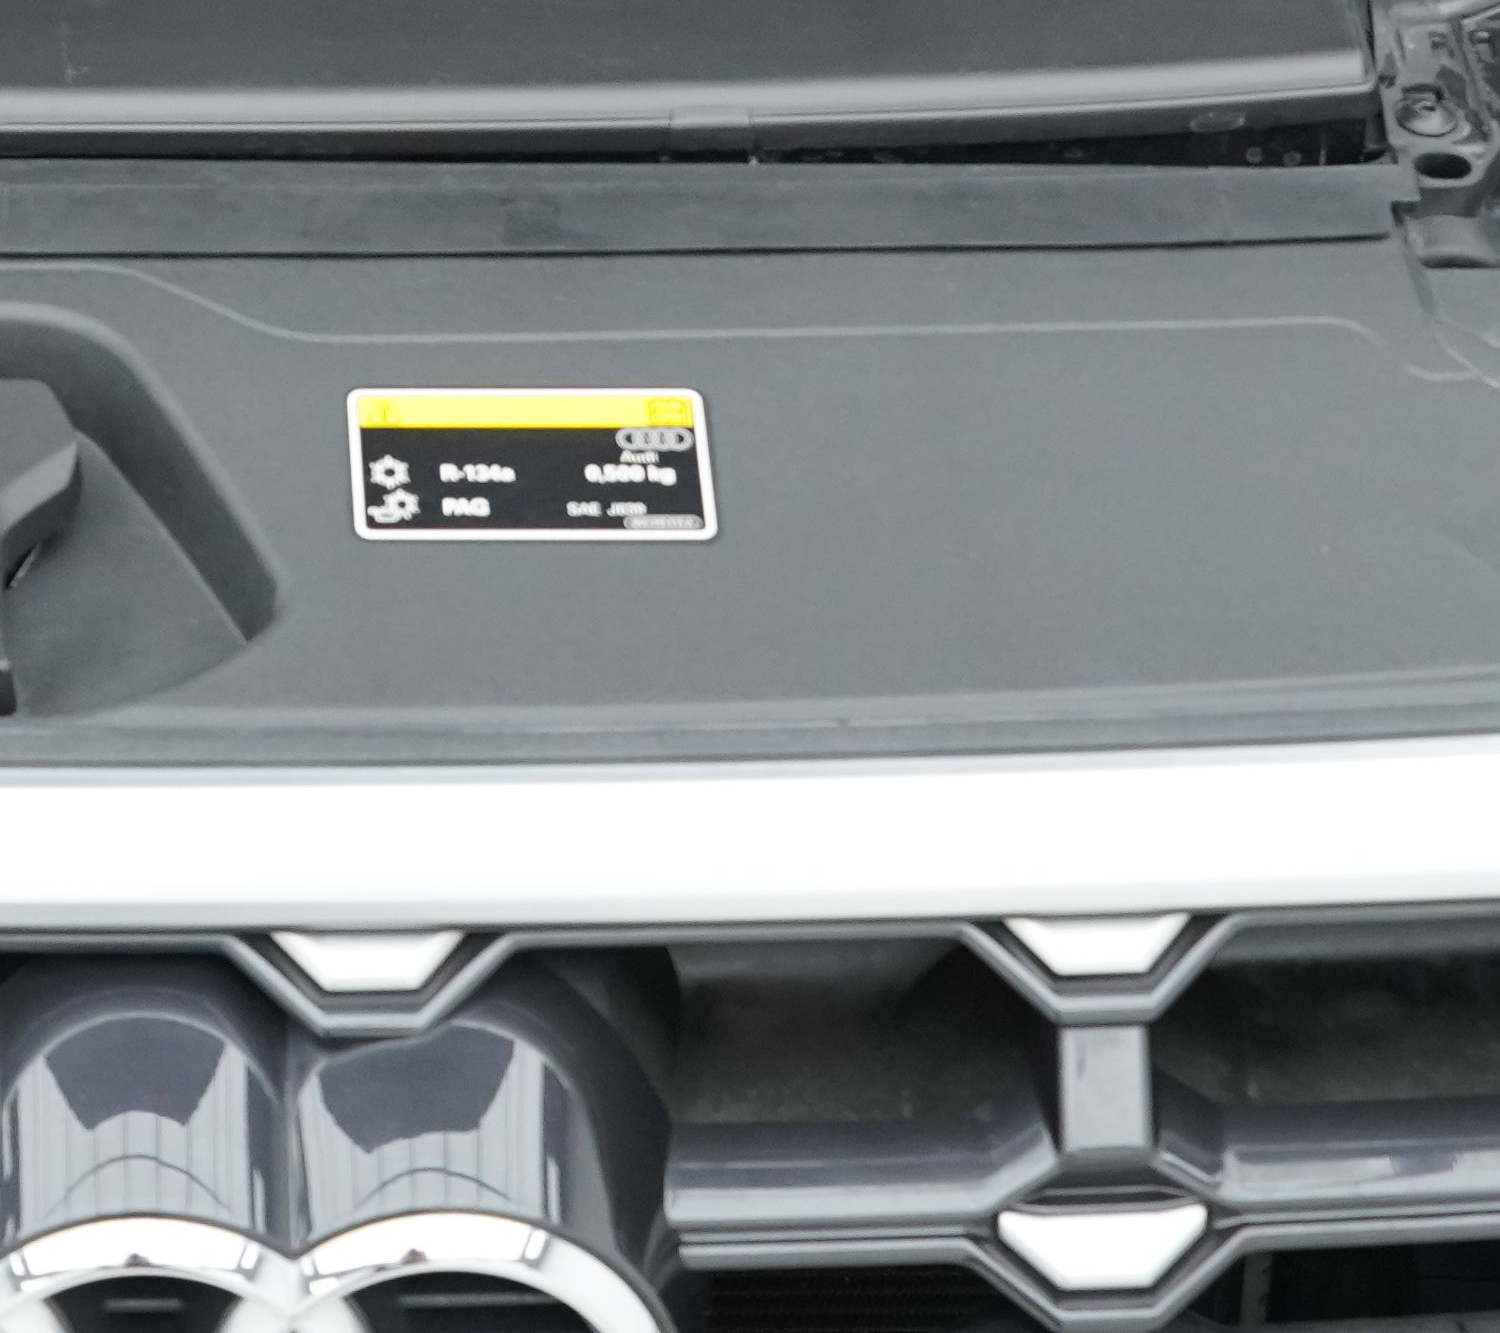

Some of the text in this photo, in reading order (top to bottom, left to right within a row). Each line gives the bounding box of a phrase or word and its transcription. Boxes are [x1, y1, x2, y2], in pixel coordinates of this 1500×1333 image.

[439, 462, 517, 483] R-134a
[646, 464, 678, 486] kg
[441, 496, 491, 517] PAG
[566, 501, 602, 518] SAE
